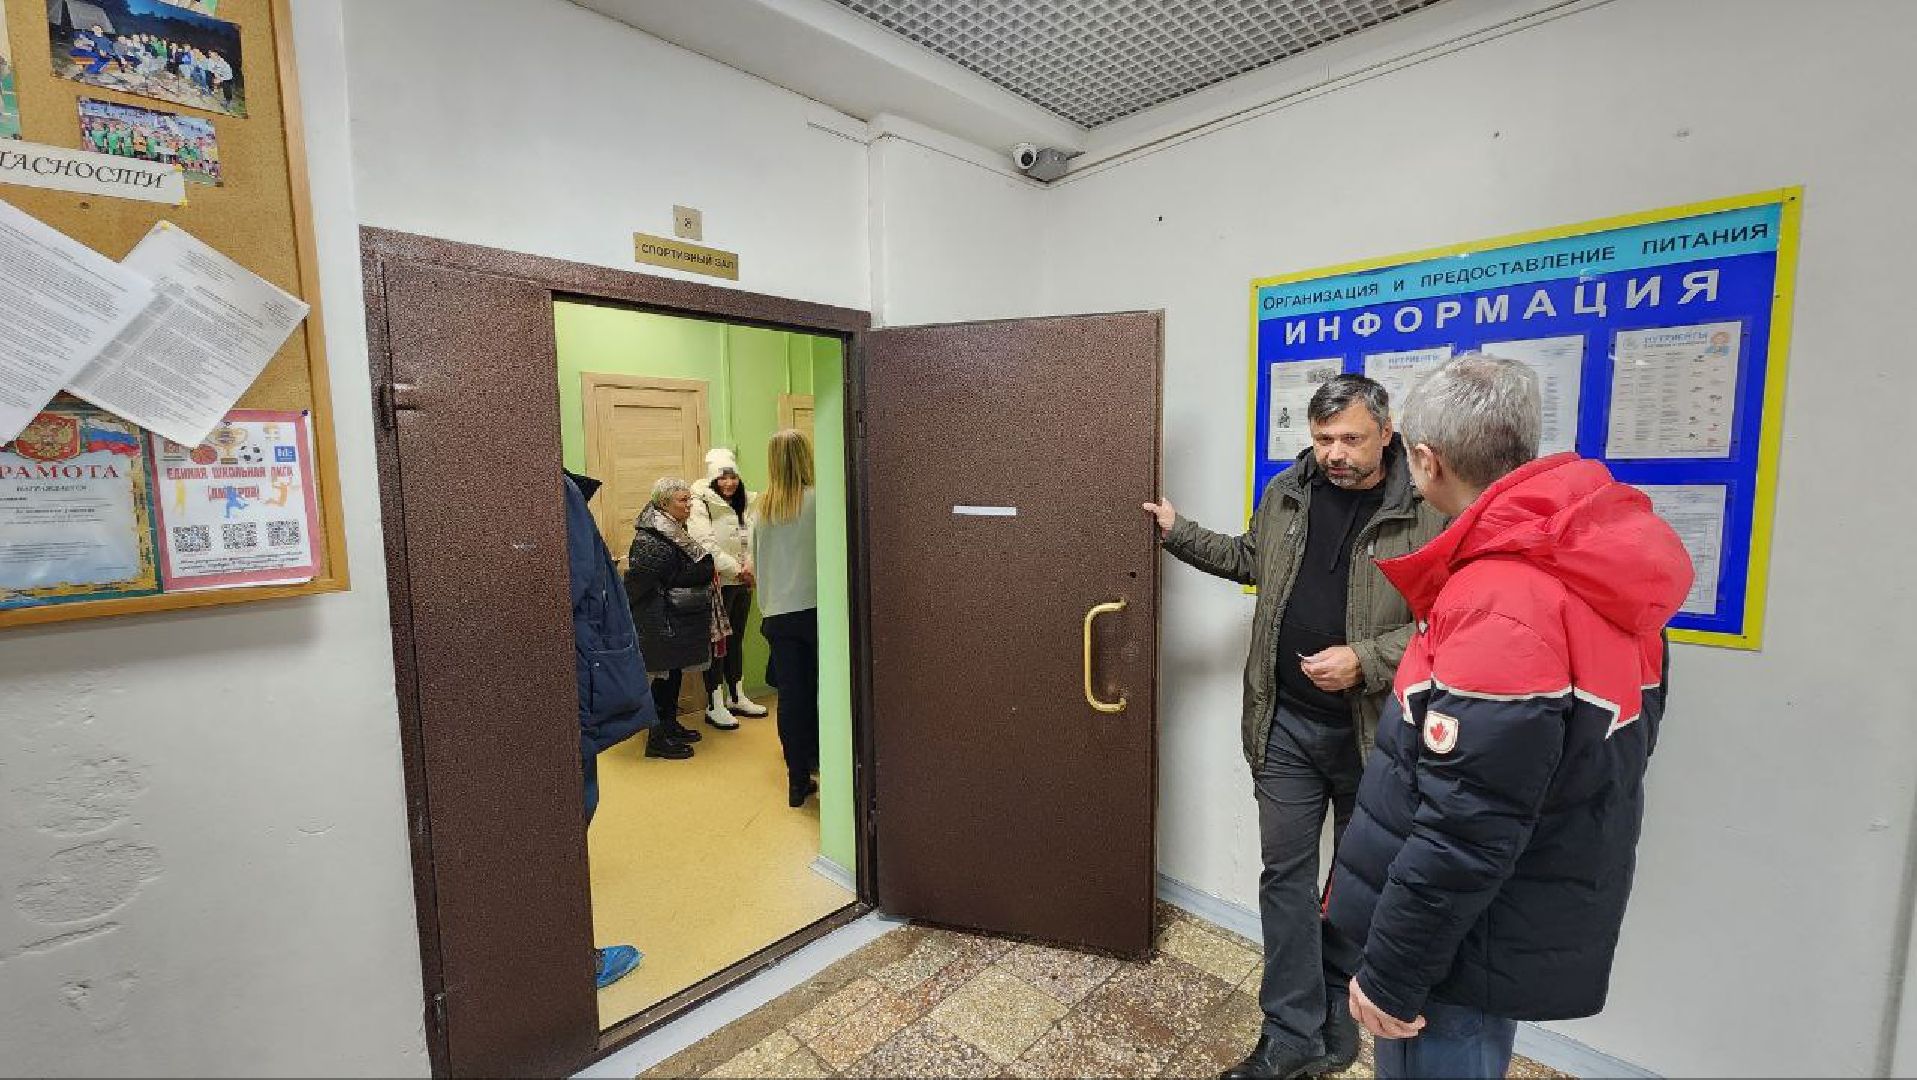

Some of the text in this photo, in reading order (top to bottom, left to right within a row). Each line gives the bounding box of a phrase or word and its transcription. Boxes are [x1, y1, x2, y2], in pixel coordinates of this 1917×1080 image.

[641, 243, 735, 270] СПОРТИВНЫЙ ЗАЛ
[1263, 223, 1768, 311] ОРГАНИЗАЦИЯ И ПРЕДОСТАВЛЕНИЕ ПИТАНИЯ
[1284, 268, 1720, 345] ИНФОРМАЦИЯ
